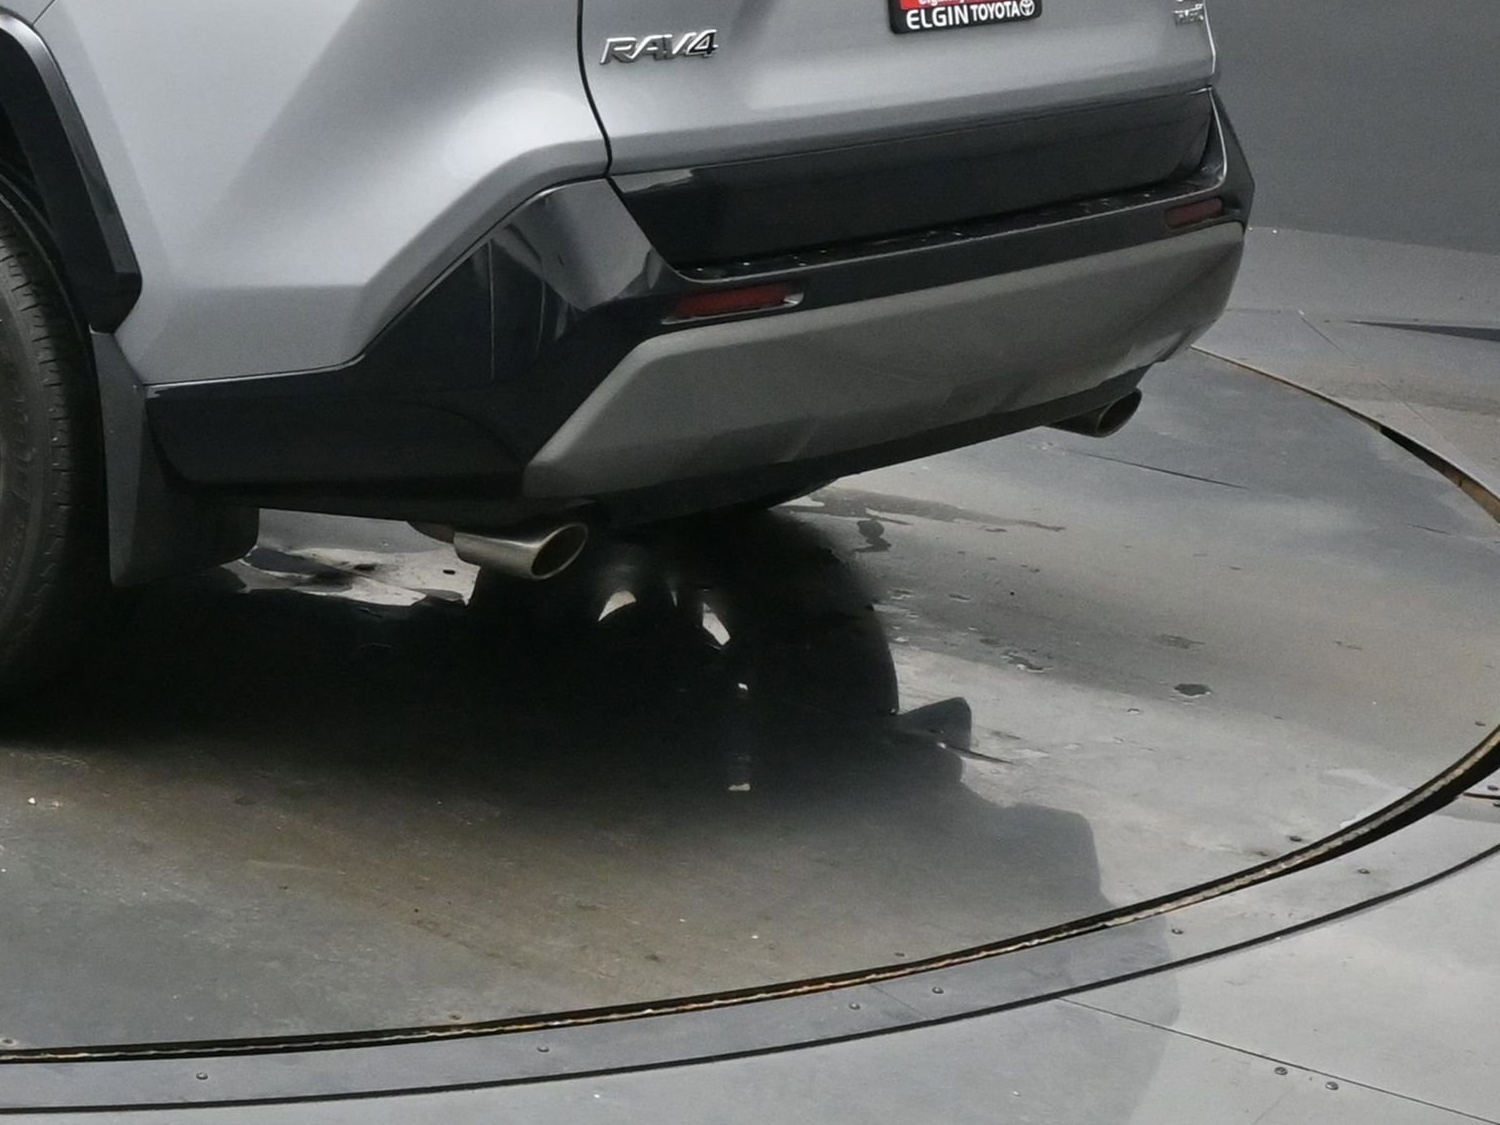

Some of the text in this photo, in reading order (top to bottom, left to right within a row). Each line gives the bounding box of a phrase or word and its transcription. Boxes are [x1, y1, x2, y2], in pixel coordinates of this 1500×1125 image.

[906, 0, 1021, 30] ELGIN TOYOTA
[600, 29, 719, 65] RAV4
